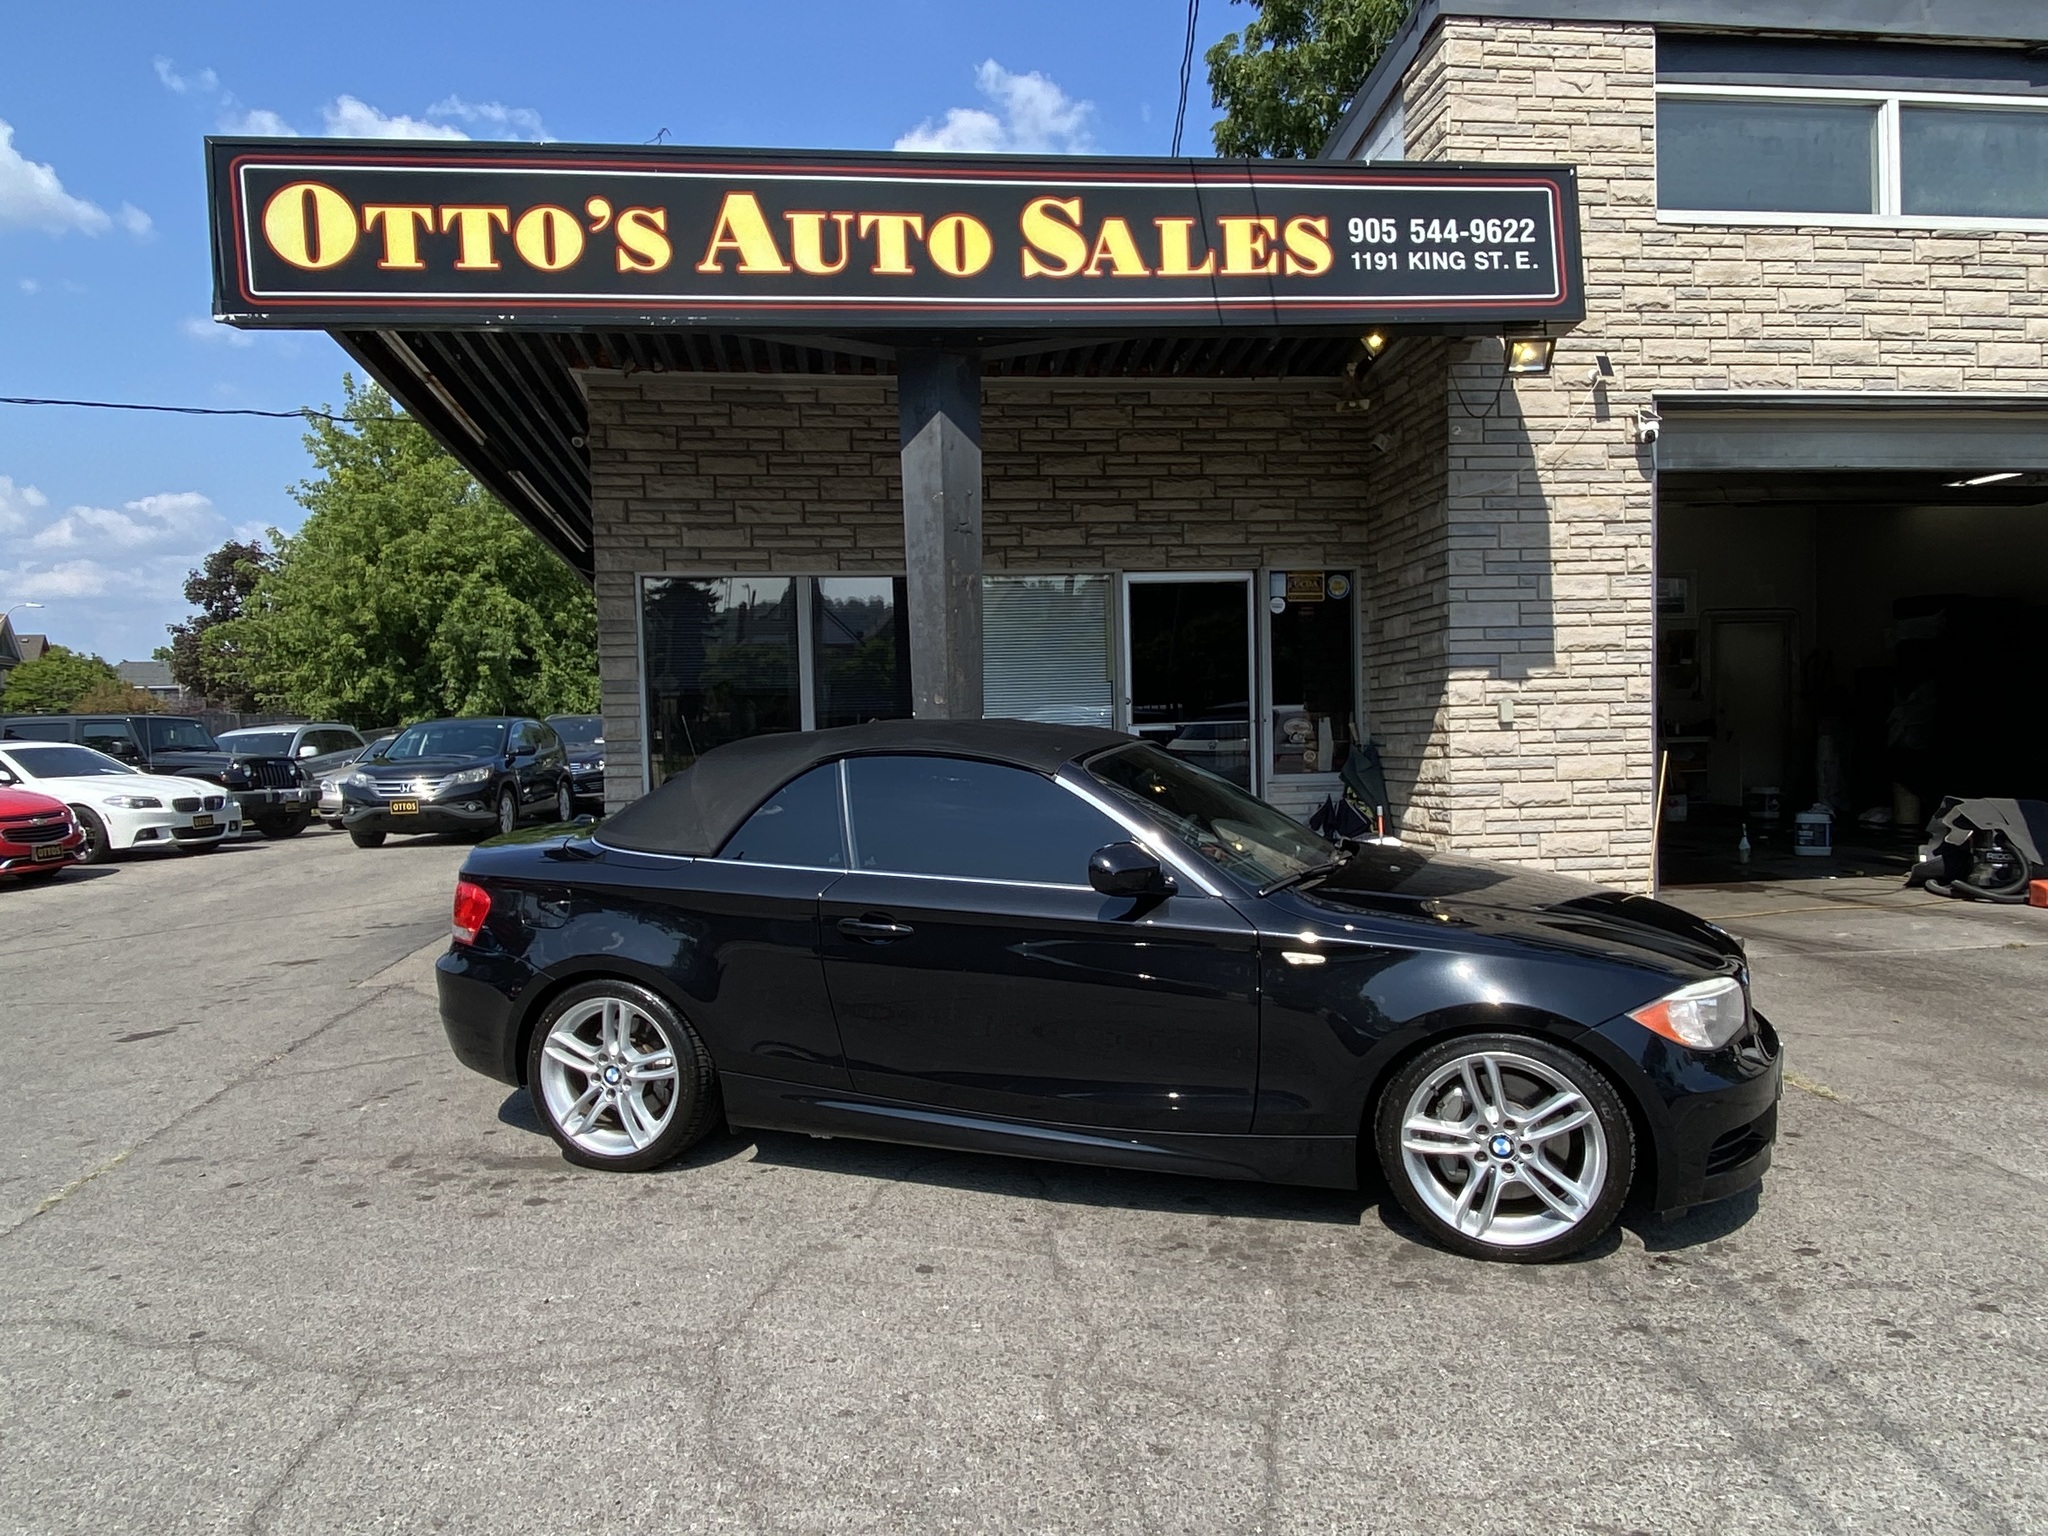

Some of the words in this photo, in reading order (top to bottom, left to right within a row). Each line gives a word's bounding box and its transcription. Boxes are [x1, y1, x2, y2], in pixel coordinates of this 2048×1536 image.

[262, 180, 673, 274] OTTO'S
[695, 191, 994, 278] AUTO
[1019, 195, 1334, 279] SALES
[1347, 218, 1397, 244] 905
[1409, 218, 1536, 244] 544-9622
[1350, 251, 1398, 271] 1191
[1408, 250, 1467, 271] KING
[1473, 250, 1510, 271] ST.
[1514, 250, 1539, 270] E.
